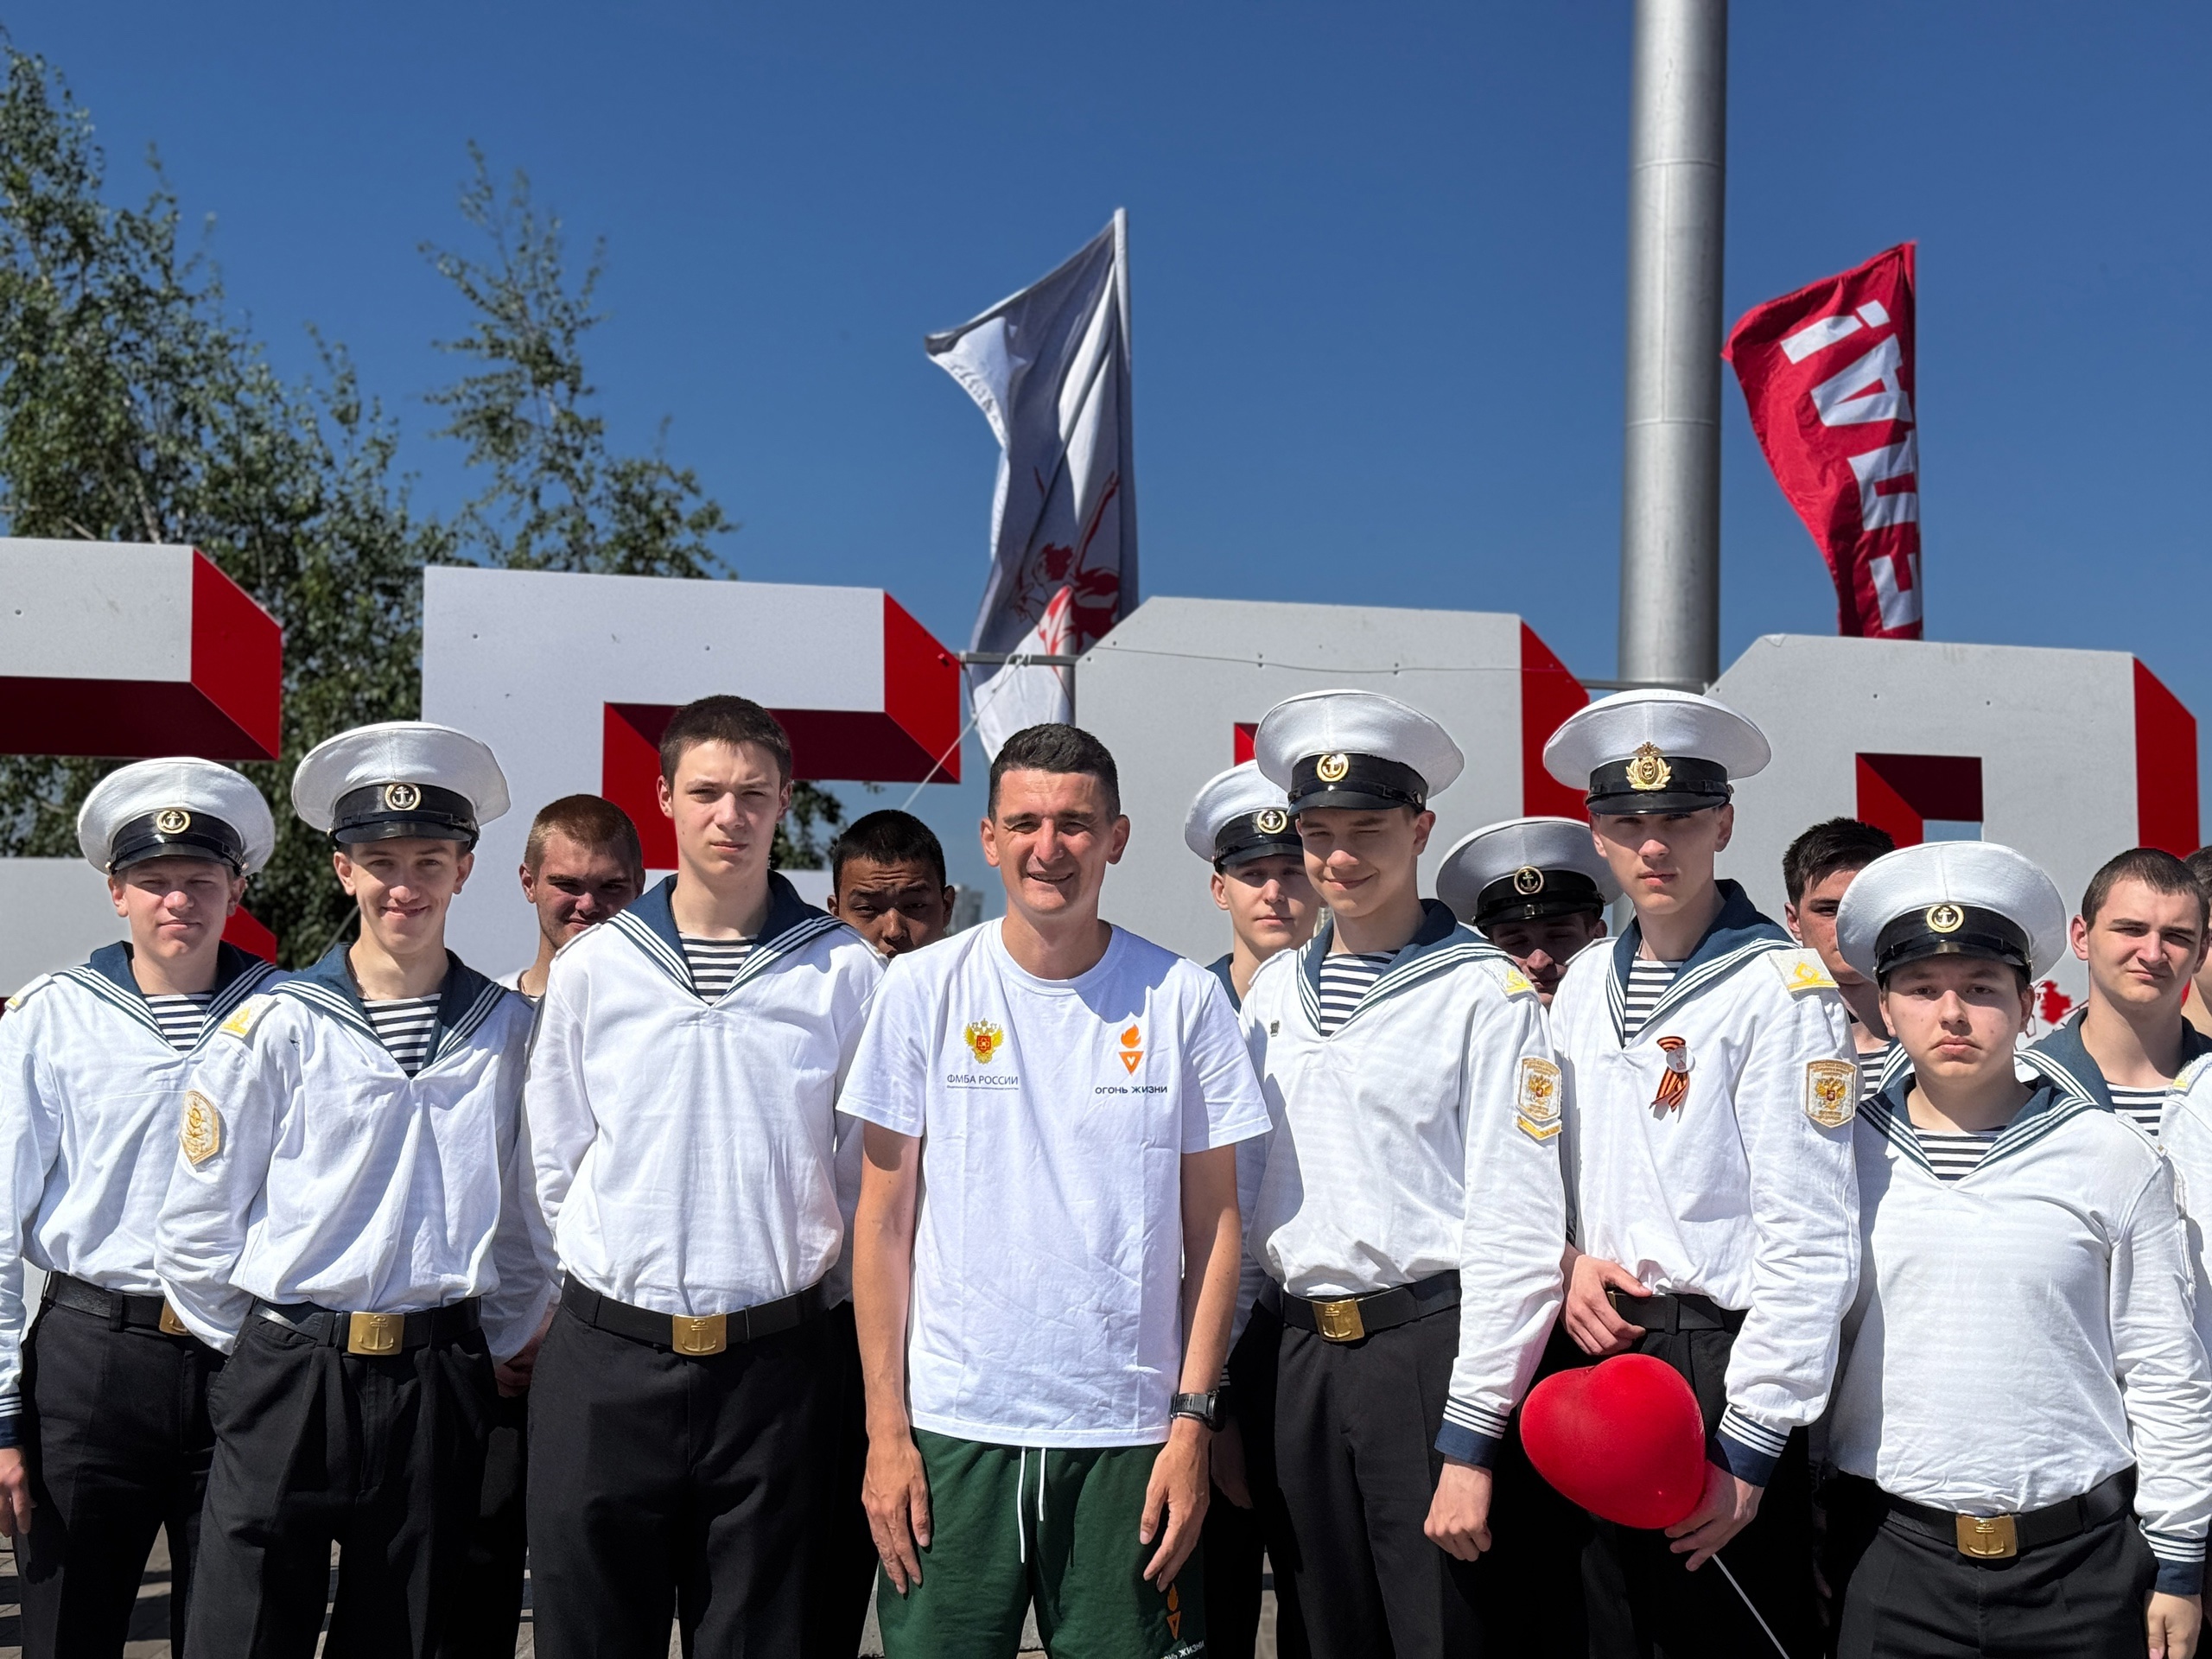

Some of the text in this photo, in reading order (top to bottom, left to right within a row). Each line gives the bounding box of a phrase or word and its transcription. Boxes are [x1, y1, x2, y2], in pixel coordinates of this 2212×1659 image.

[947, 1074, 1019, 1085] ФМБА РОССИИ
[1095, 1085, 1168, 1095] ОГОНЬ ЖИЗНИ
